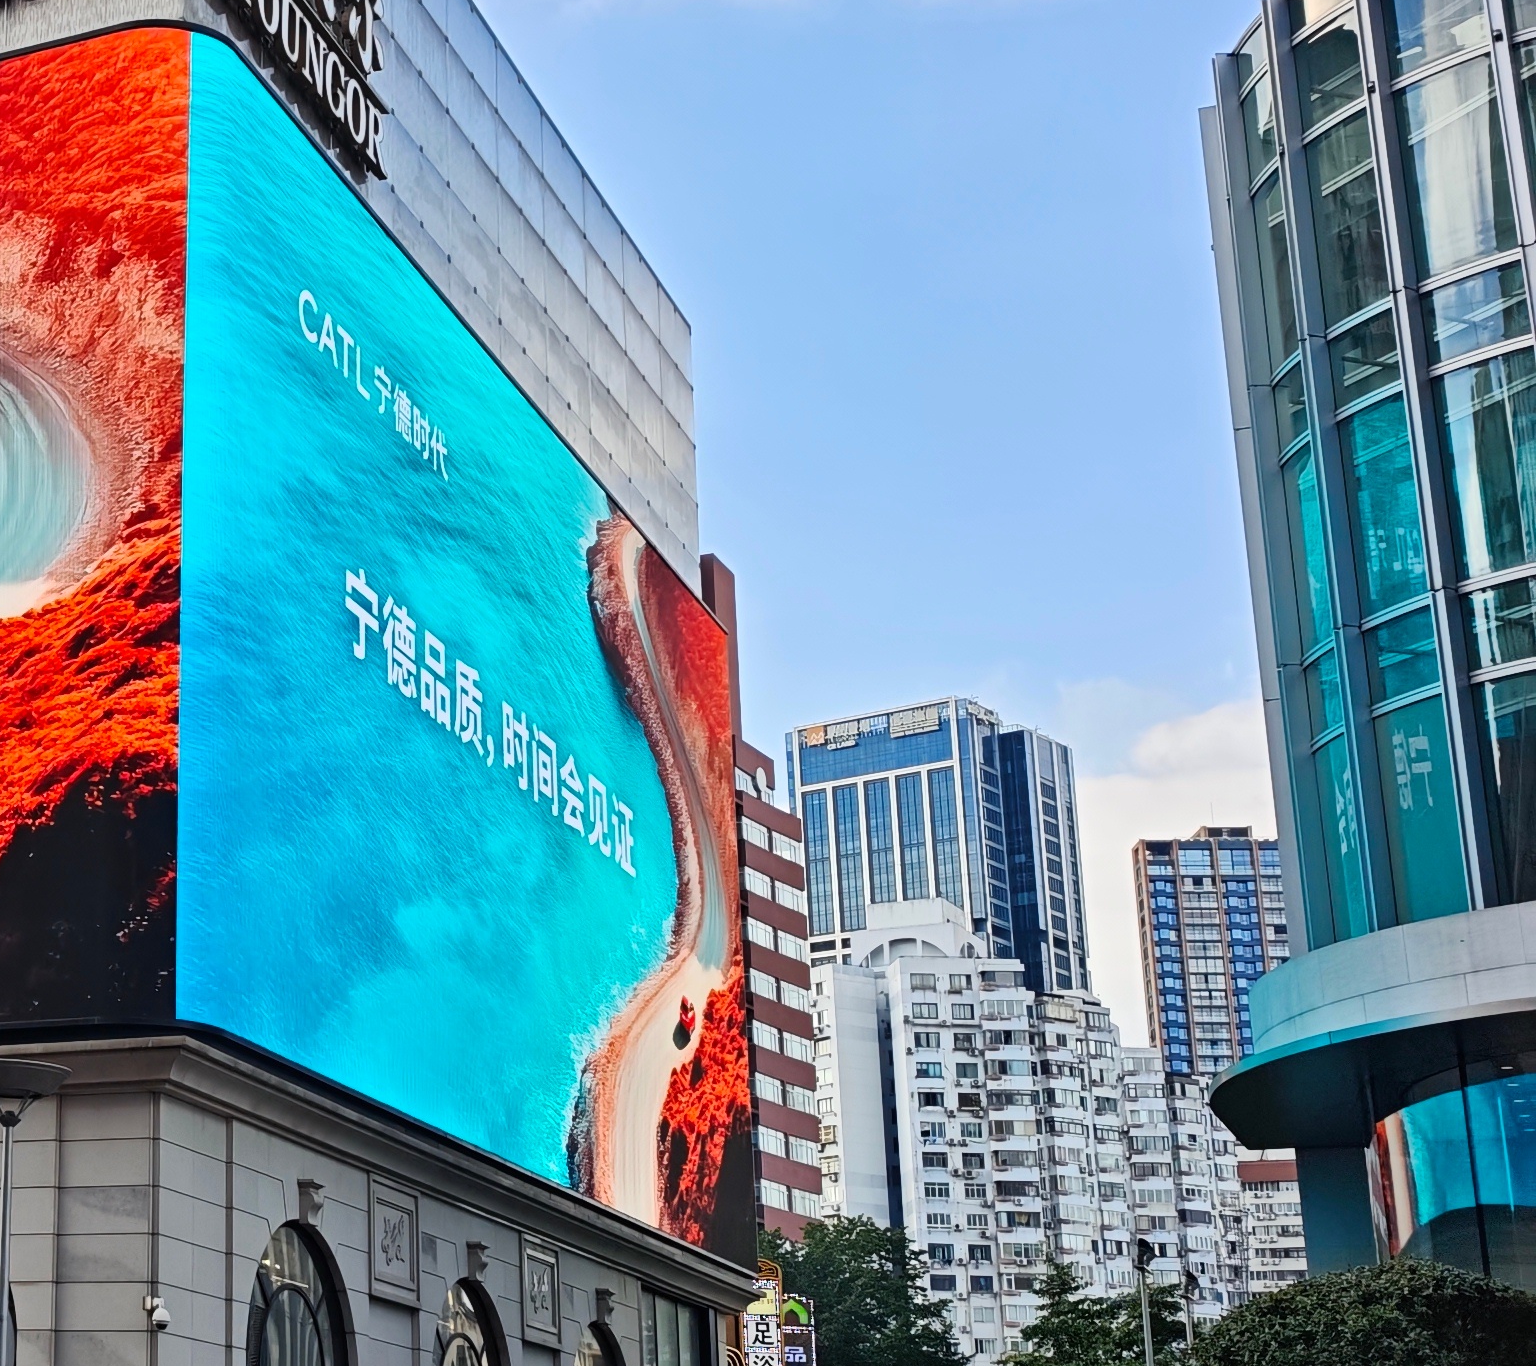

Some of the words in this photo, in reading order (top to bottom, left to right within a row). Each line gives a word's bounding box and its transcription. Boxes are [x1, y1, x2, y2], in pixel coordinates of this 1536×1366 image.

[298, 289, 370, 400] CATL
[373, 365, 449, 482] 宁德时代
